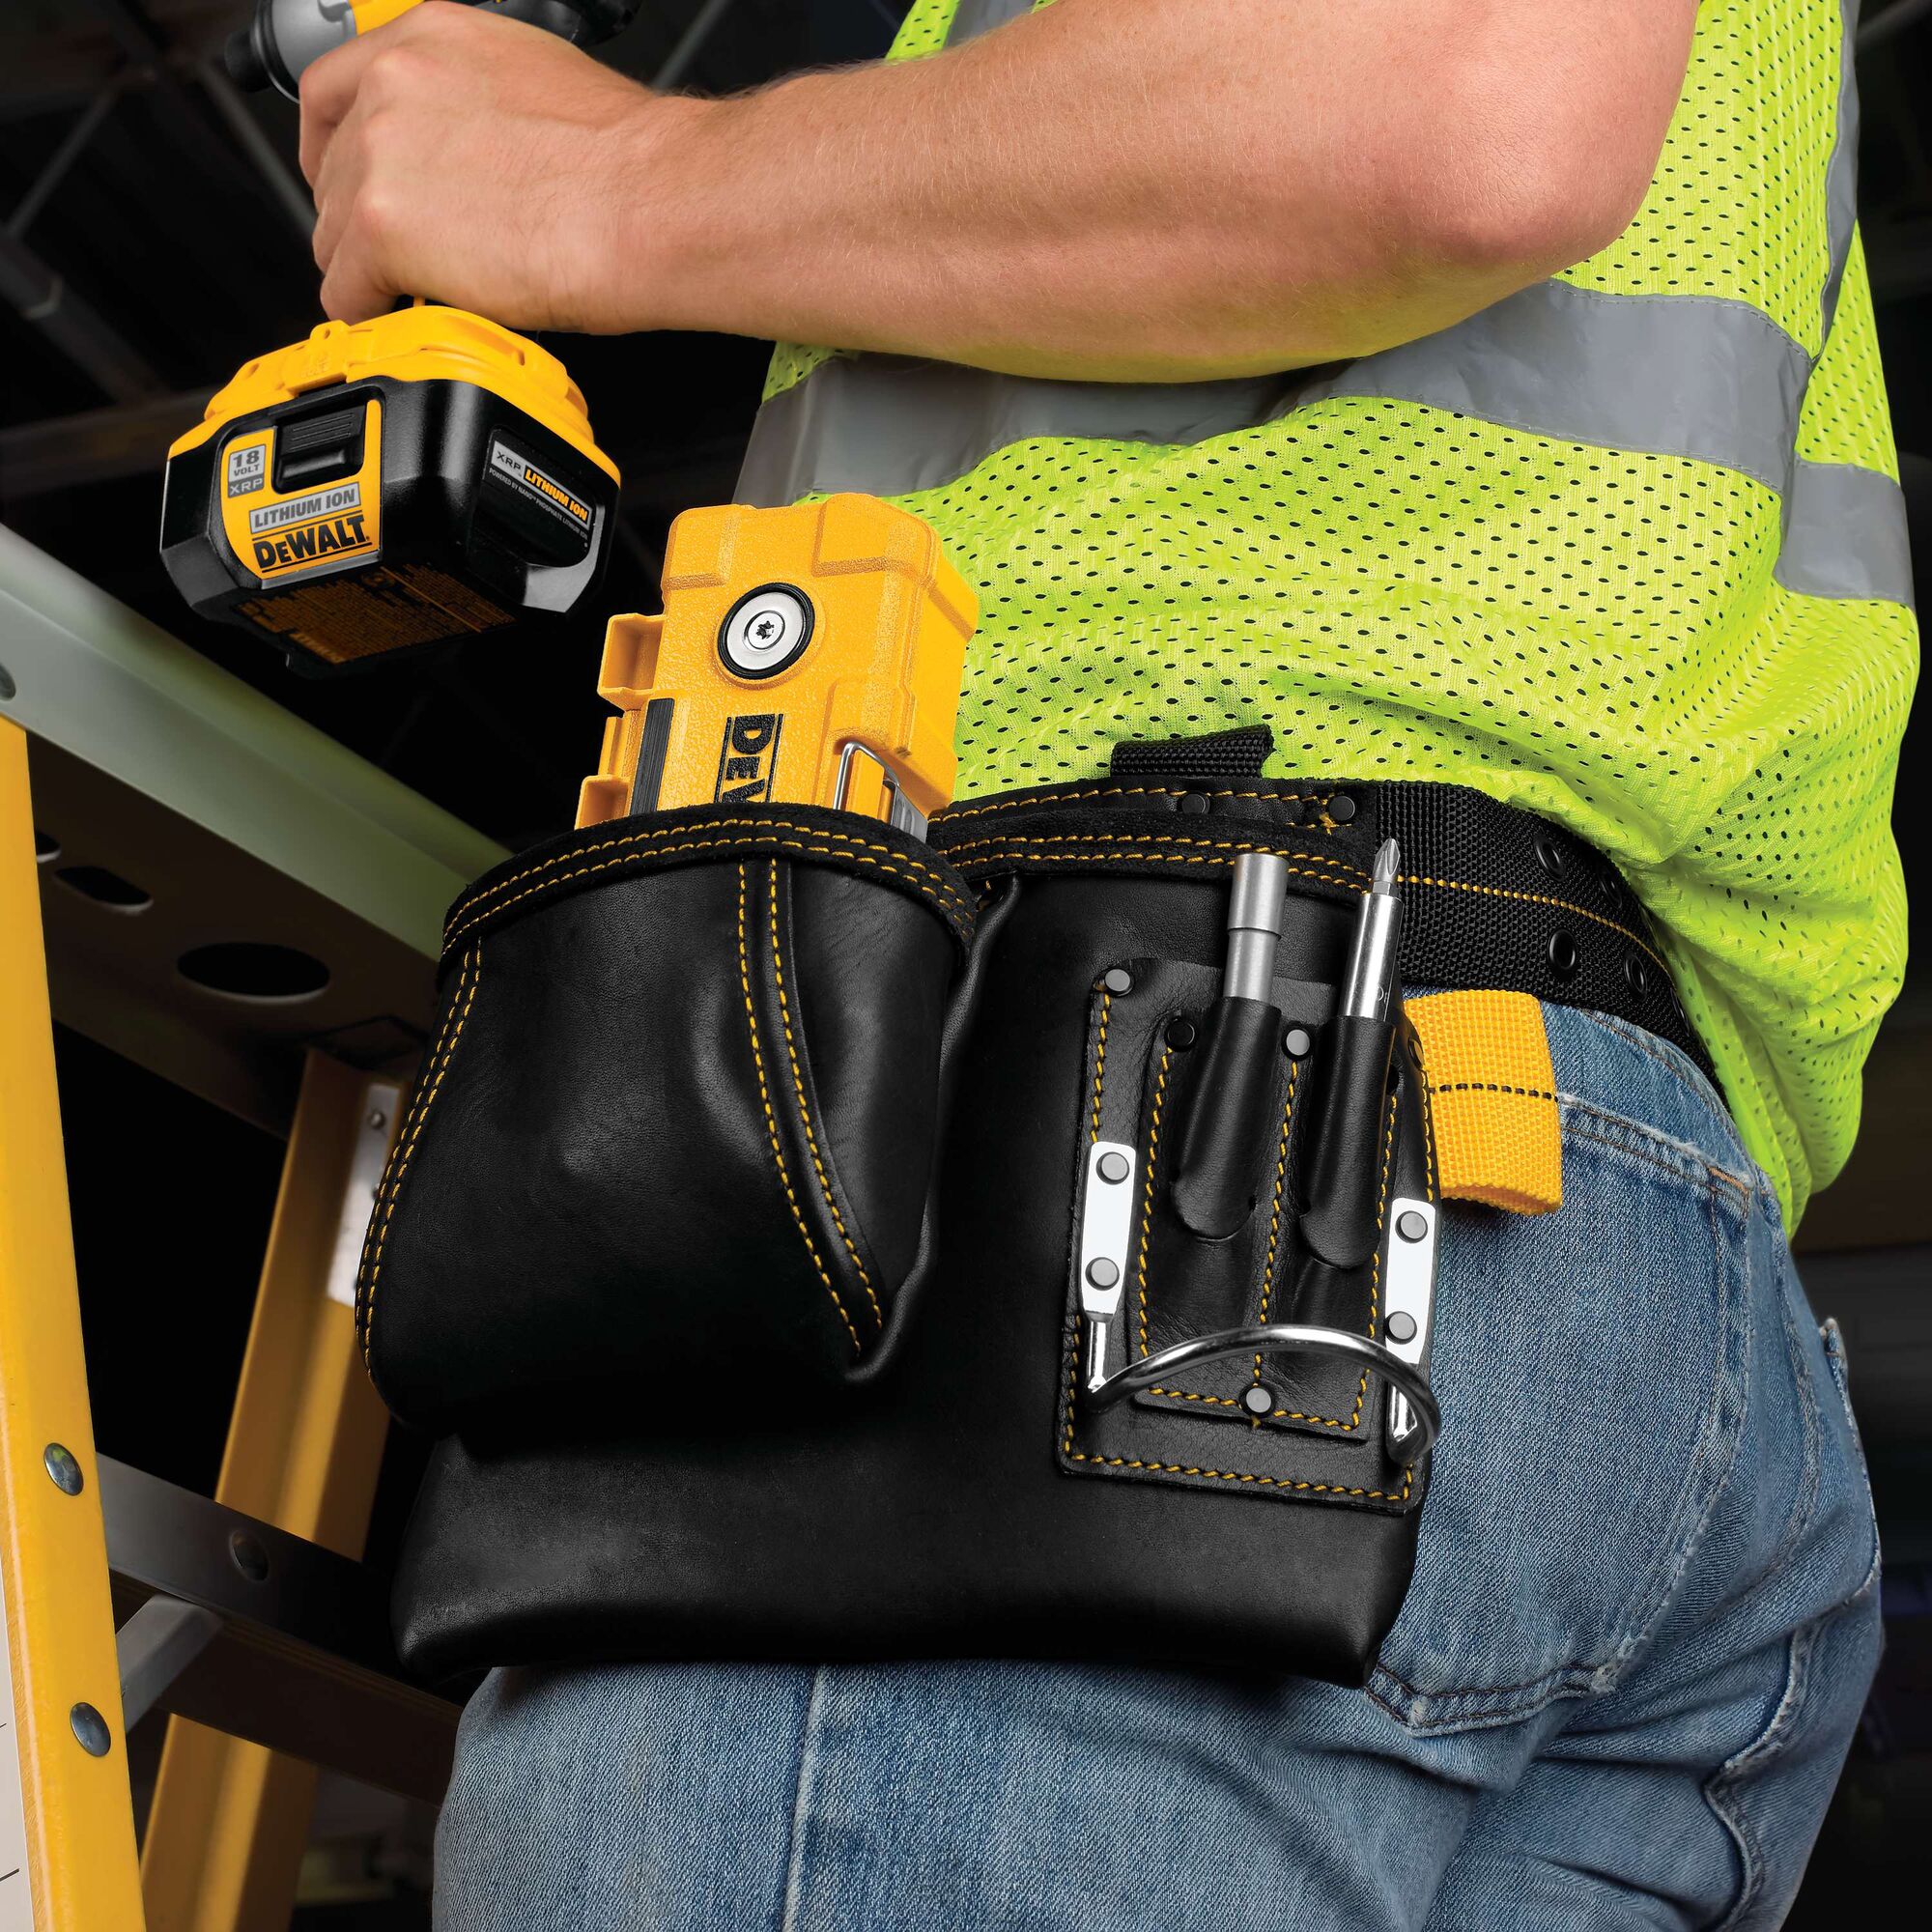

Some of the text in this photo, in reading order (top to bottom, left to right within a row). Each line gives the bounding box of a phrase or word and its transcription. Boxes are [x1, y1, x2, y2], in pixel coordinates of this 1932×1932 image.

[233, 449, 260, 469] 18
[234, 464, 260, 477] VOLT
[229, 477, 263, 496] XRP
[497, 450, 588, 522] XRP LITHIUM ION
[254, 488, 356, 528] LITHIUM ION
